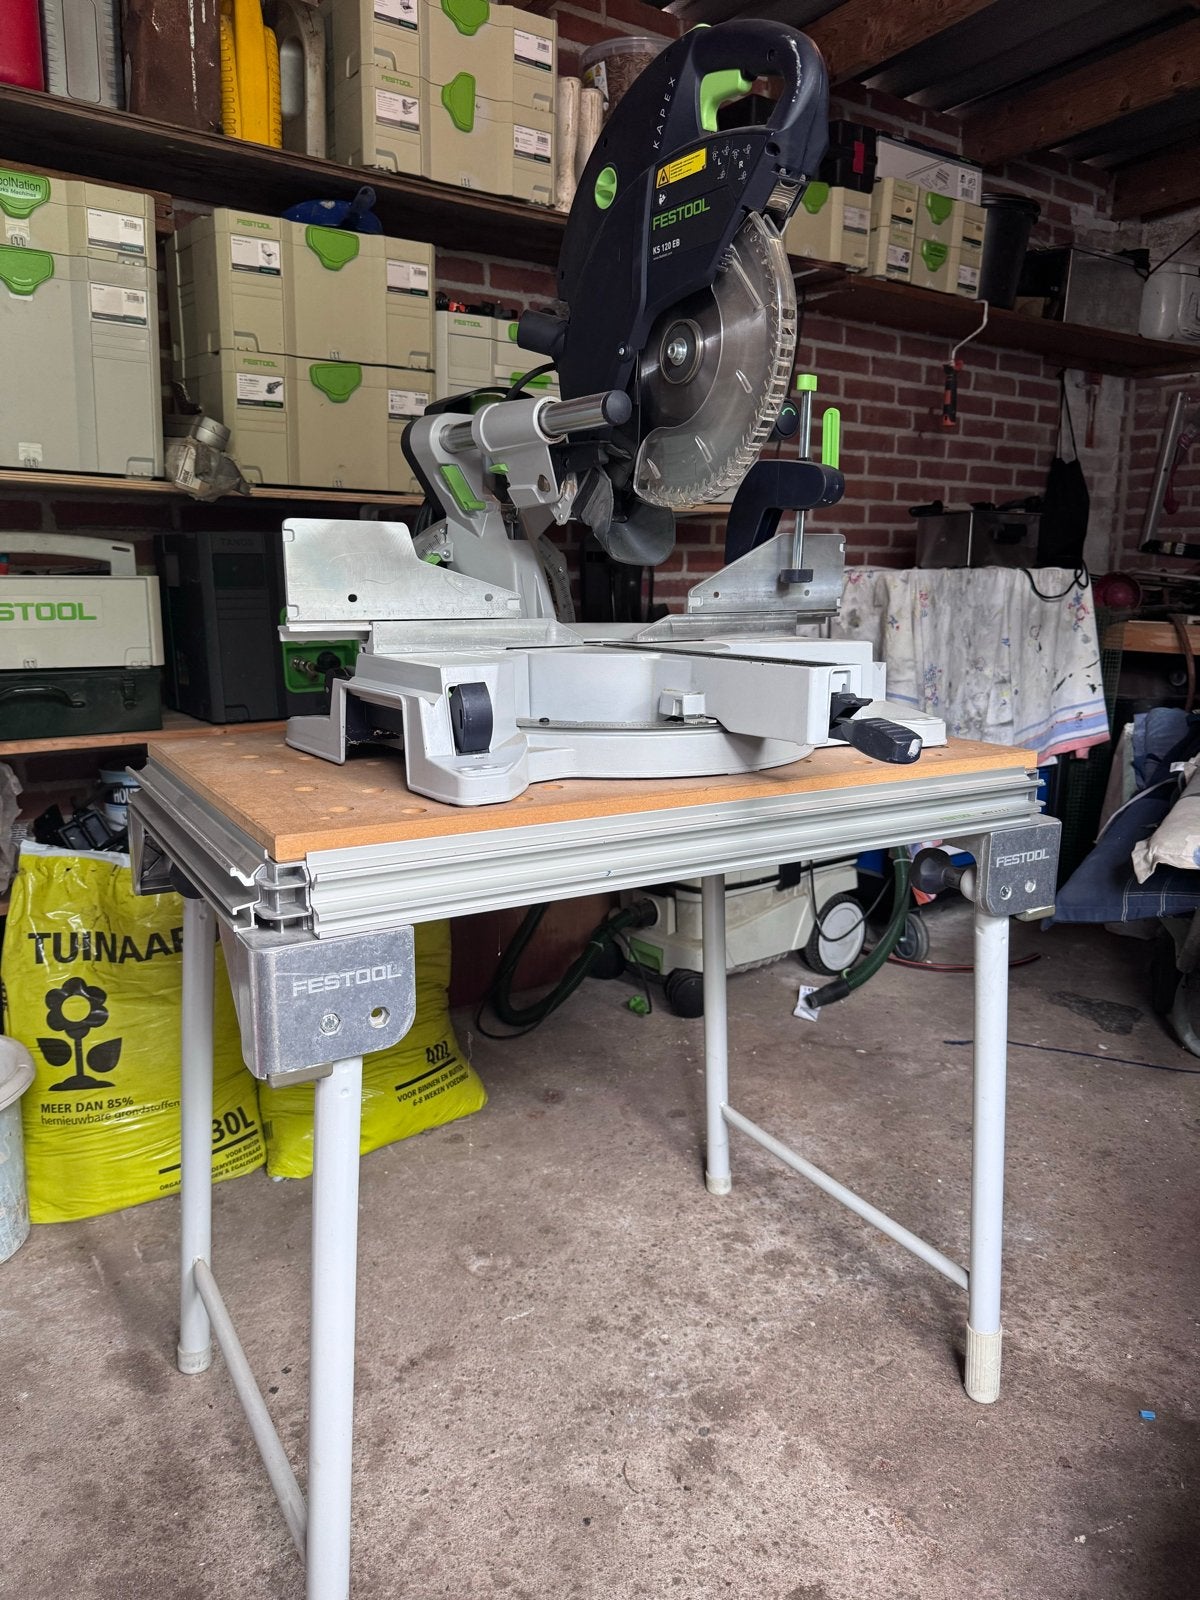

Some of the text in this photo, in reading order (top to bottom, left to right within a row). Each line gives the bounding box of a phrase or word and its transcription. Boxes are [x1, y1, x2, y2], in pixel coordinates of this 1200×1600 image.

[653, 77, 676, 149] KAPEX
[653, 198, 711, 231] FESTOOL
[652, 245, 661, 256] KS
[661, 241, 672, 252] 120
[995, 848, 1050, 868] FESTOOL
[292, 964, 402, 997] FESTOOL
[41, 1096, 134, 1114] MEER DAN 85%
[397, 1089, 417, 1102] VOOR
[41, 1112, 112, 1126] hernieuwbare
